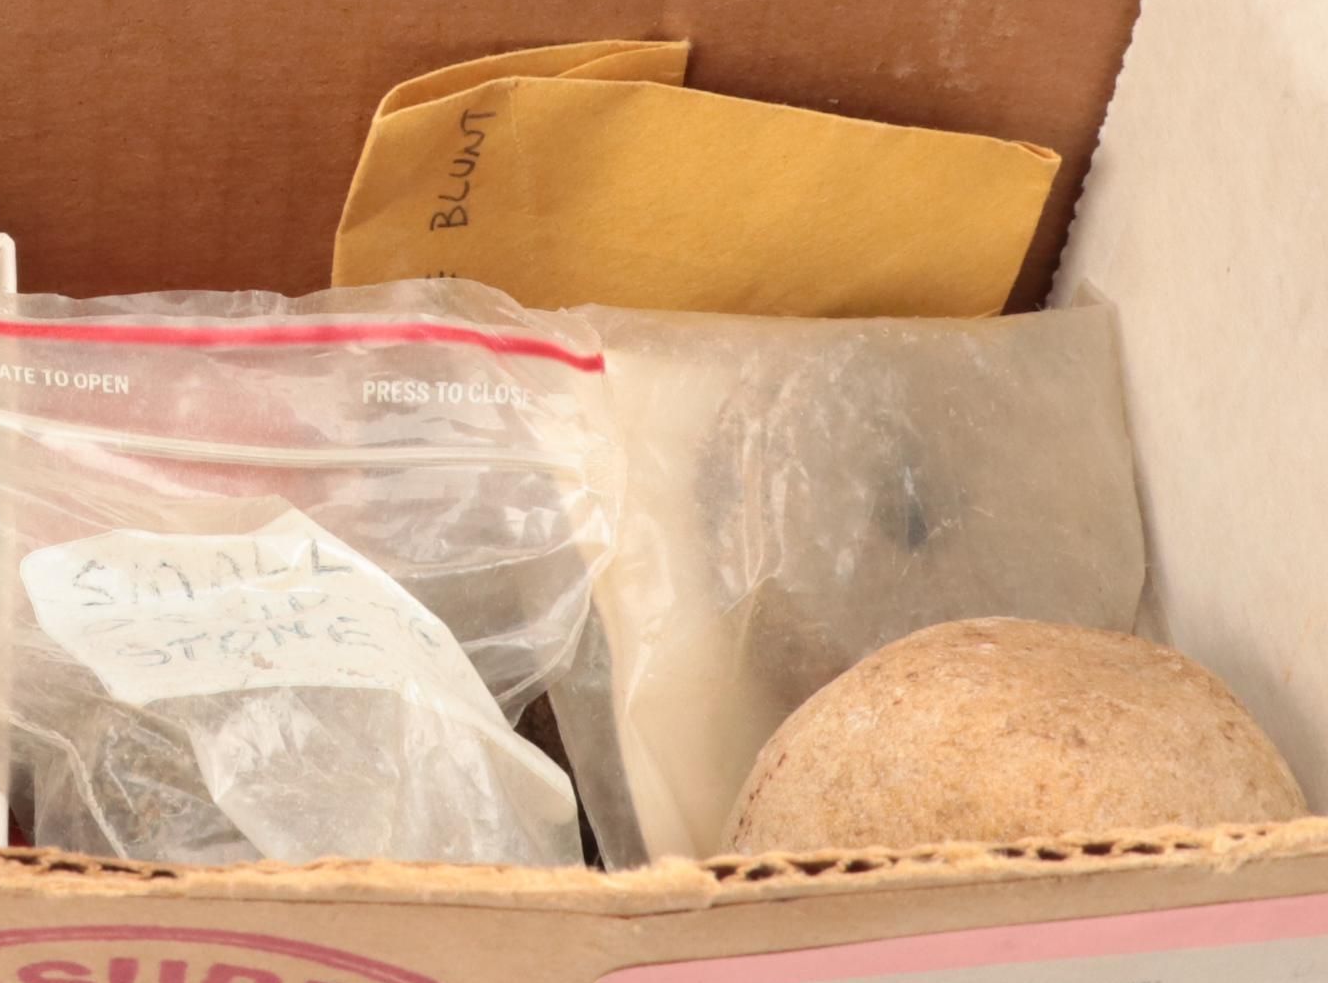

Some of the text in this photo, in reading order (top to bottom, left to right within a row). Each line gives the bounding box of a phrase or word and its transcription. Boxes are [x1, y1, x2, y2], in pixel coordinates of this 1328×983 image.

[429, 109, 497, 231] BLUNT
[41, 368, 69, 387] TO
[73, 372, 130, 395] OPEN
[362, 380, 431, 404] PRESS
[435, 381, 464, 404] TO
[72, 537, 353, 607] SMALL
